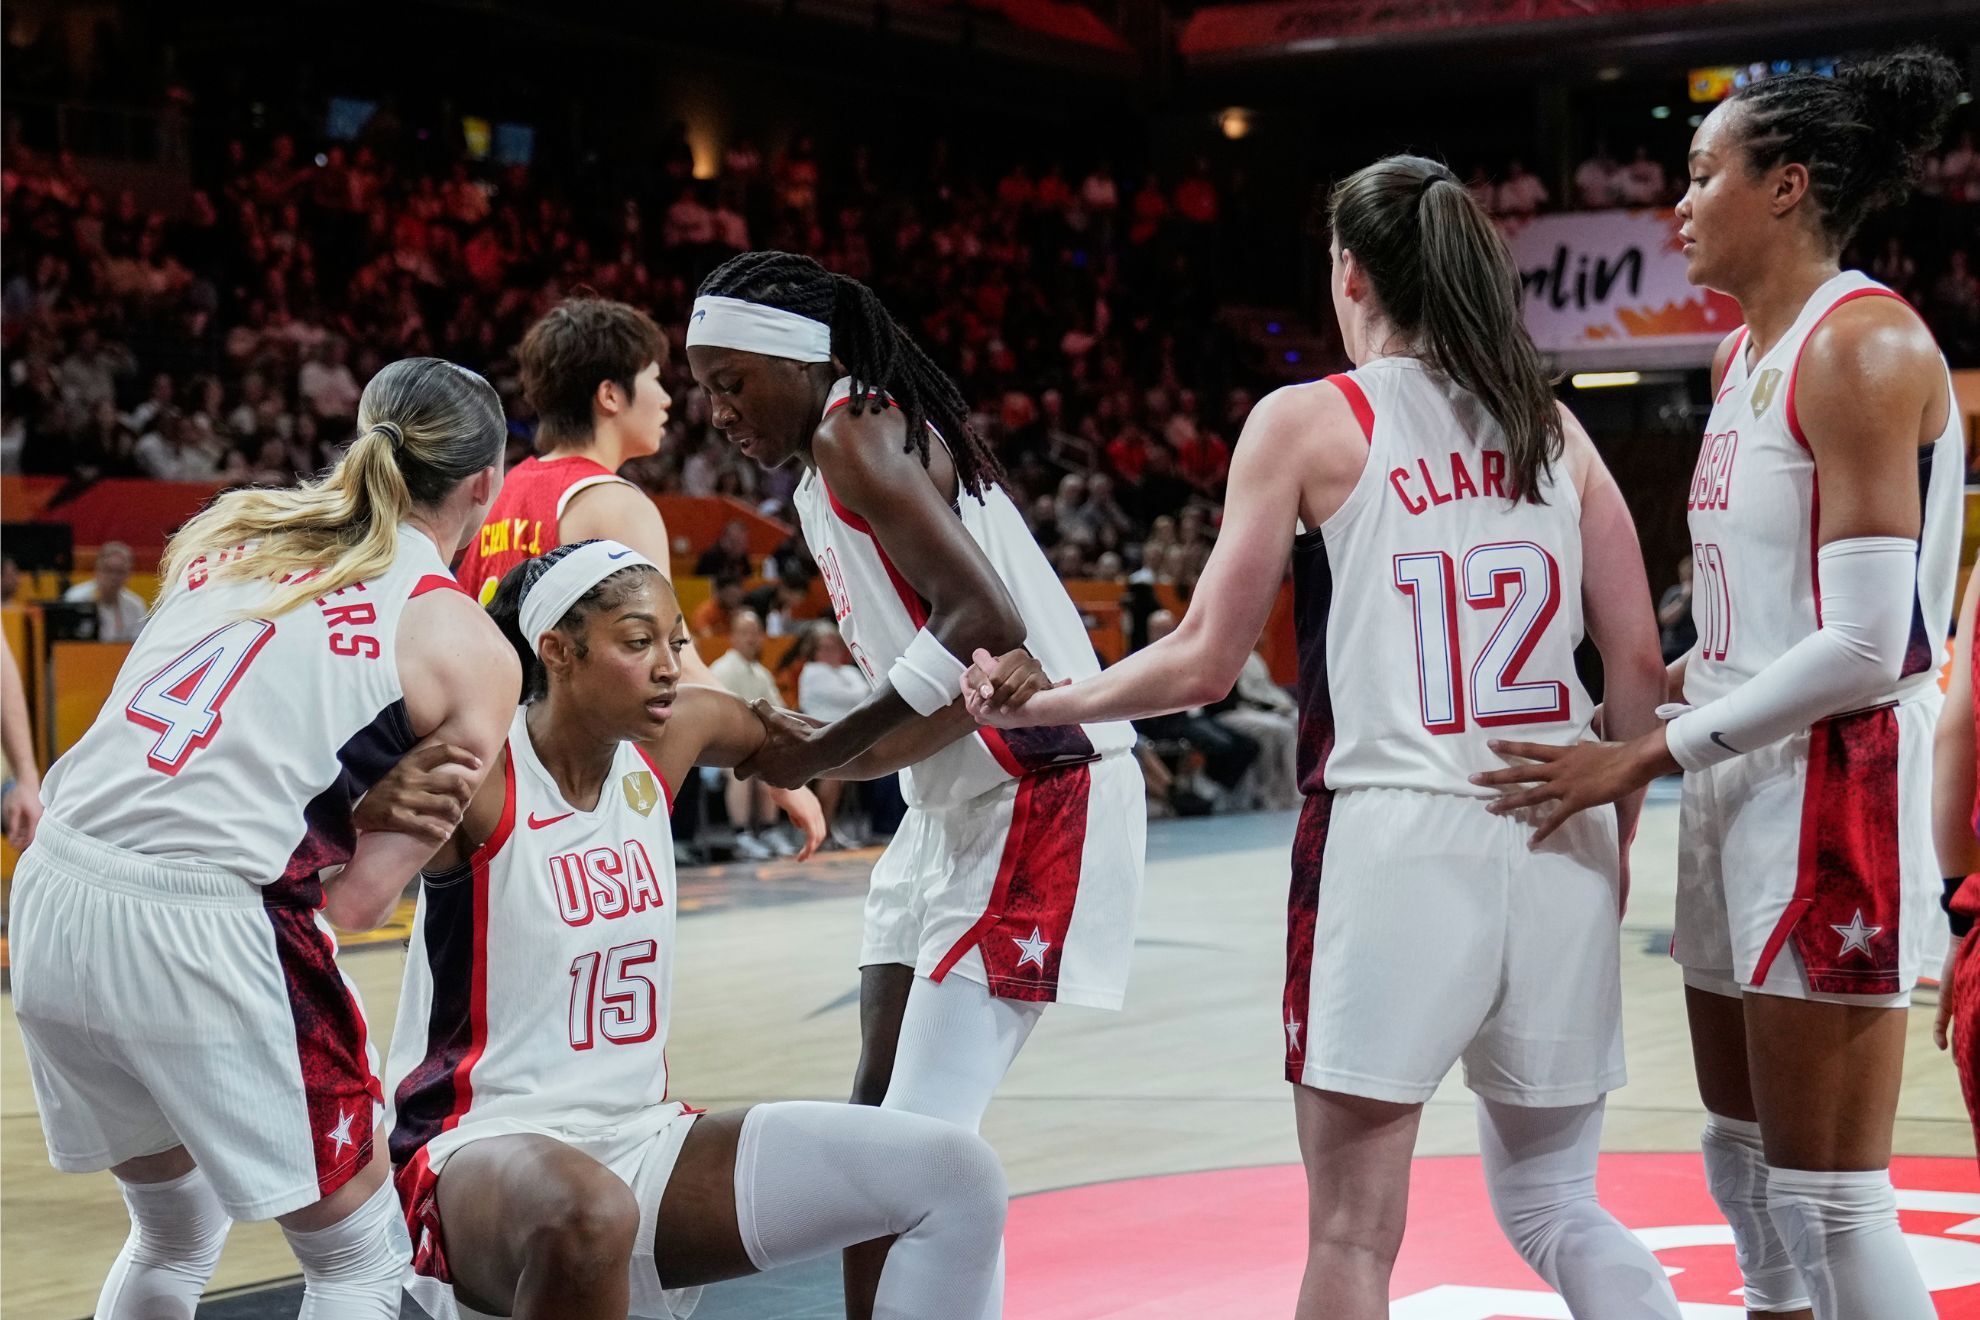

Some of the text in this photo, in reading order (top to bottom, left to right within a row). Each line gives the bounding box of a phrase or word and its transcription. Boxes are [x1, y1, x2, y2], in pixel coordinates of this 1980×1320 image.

[1390, 450, 1538, 516] CLAR
[1687, 430, 1738, 511] USA
[817, 547, 851, 622] SA
[1694, 543, 1731, 662] 11
[1392, 541, 1571, 736] 12
[126, 617, 277, 776] 4
[549, 839, 664, 927] USA
[568, 939, 658, 1051] 15
